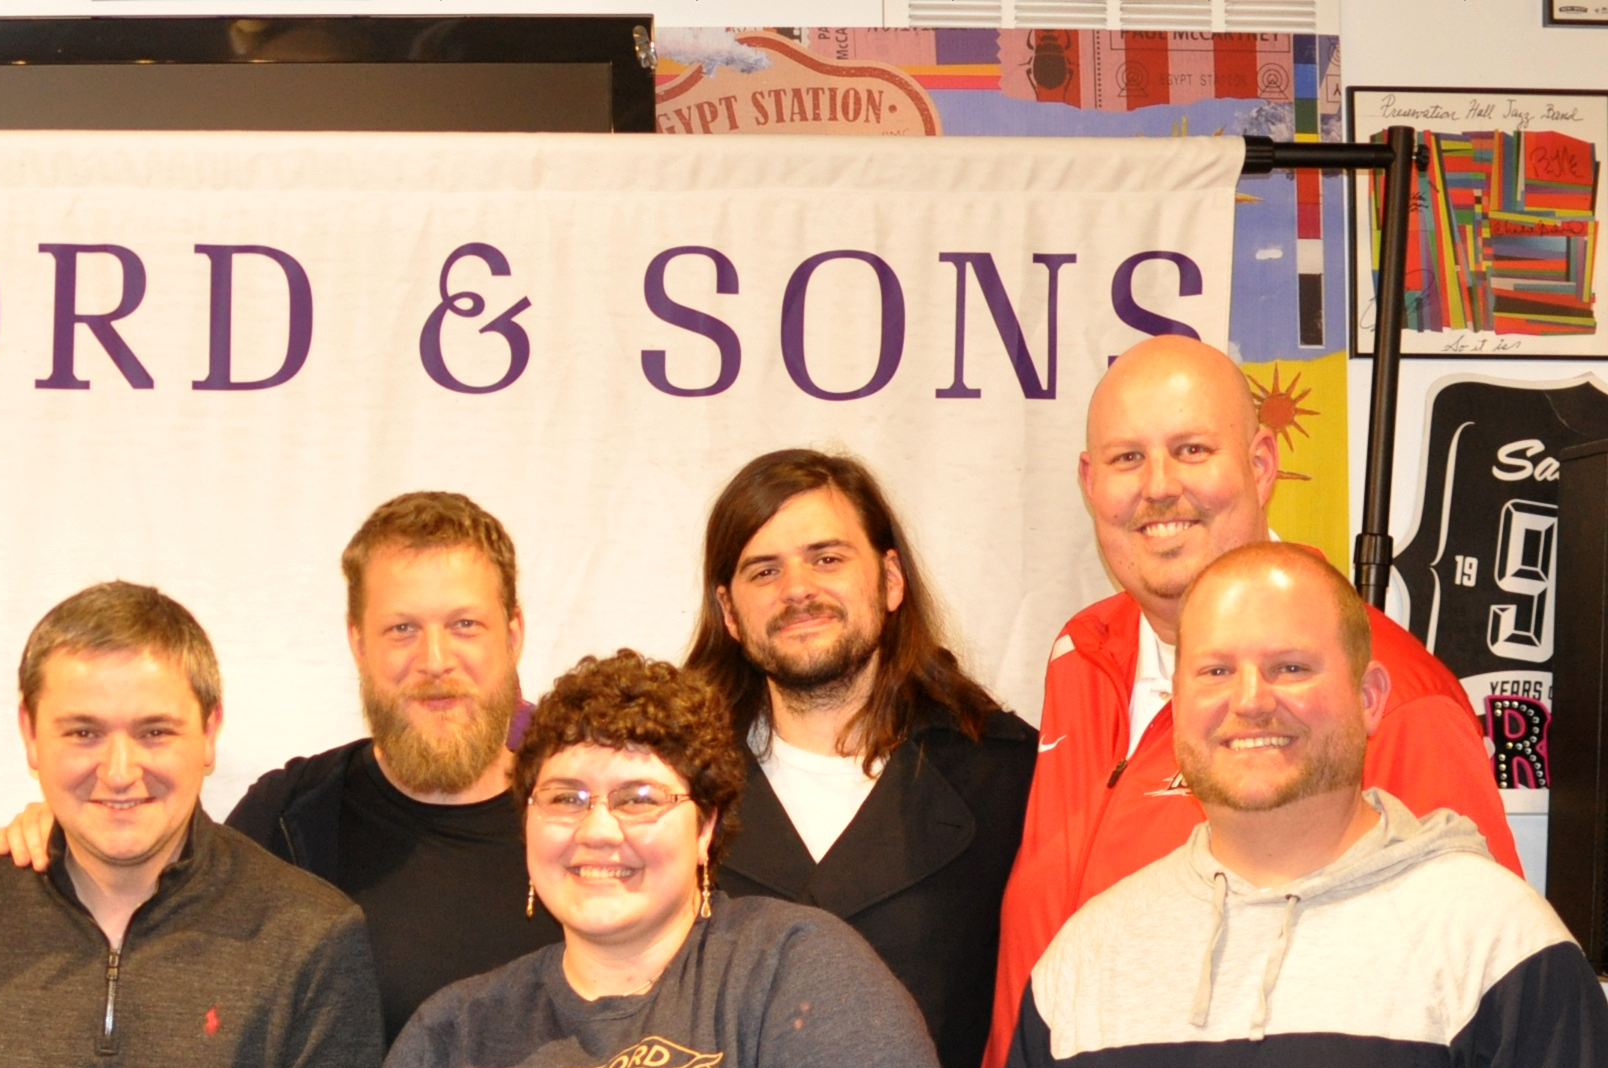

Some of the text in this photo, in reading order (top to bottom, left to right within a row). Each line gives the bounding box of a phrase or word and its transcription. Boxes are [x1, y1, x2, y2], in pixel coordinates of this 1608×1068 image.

[656, 87, 884, 134] GYPT STATION
[1465, 98, 1495, 120] Hall
[1502, 99, 1535, 130] Jazz
[1540, 103, 1584, 122] Band
[419, 242, 533, 394] &
[640, 245, 1204, 402] SONS
